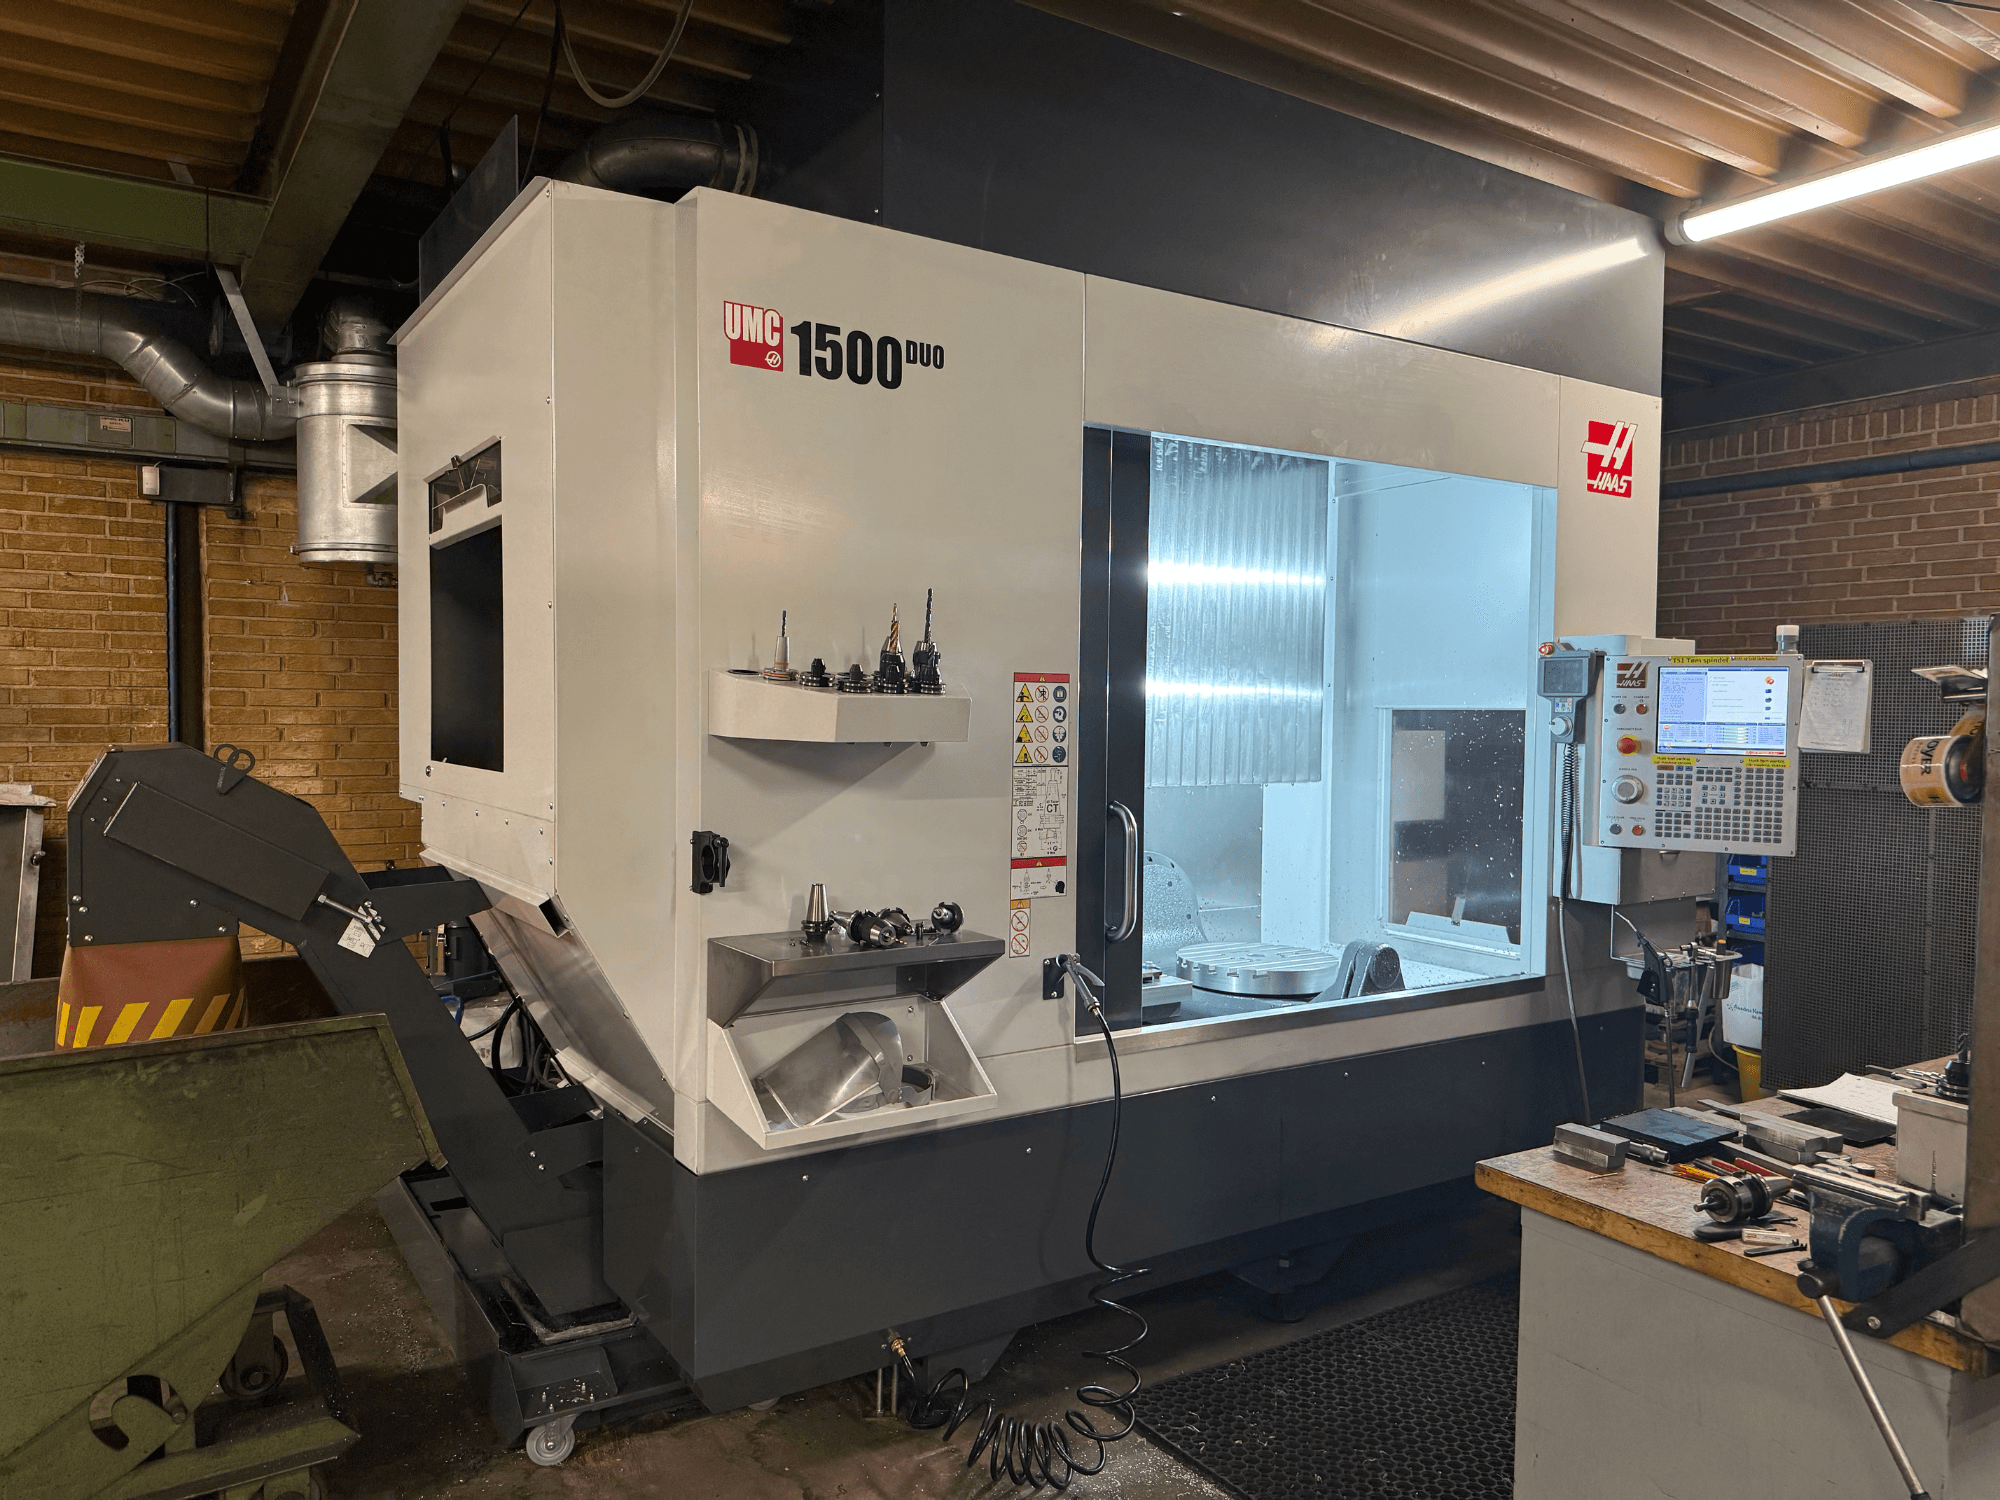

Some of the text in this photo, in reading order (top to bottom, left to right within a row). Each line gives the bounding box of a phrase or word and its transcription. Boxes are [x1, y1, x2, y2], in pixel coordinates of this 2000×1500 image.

[724, 302, 782, 347] UMC
[791, 321, 945, 390] 1500 DUO
[1587, 471, 1633, 494] HAAS
[1920, 739, 1944, 776] OYER
[1046, 804, 1059, 813] CT
